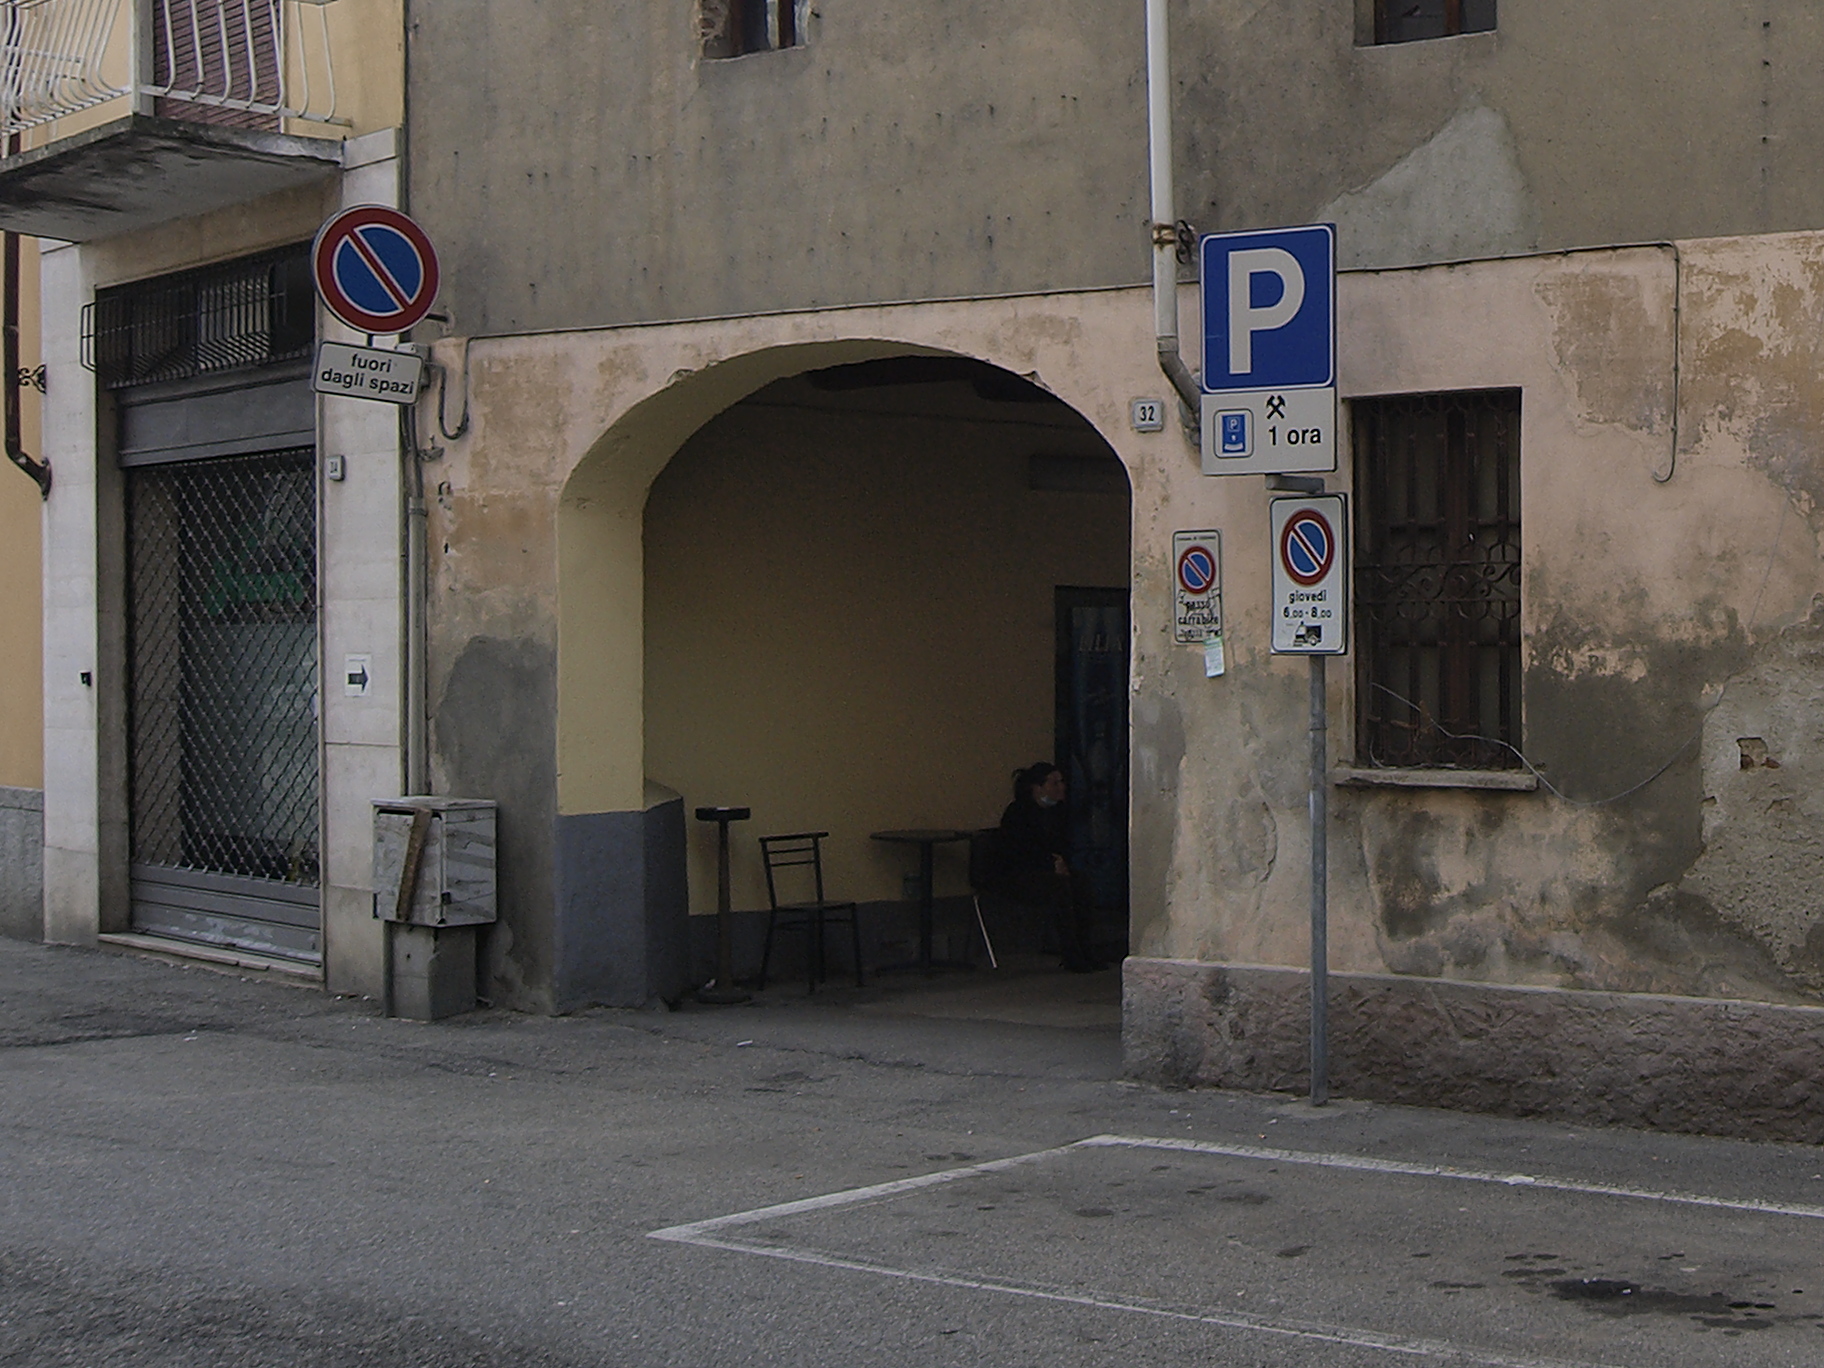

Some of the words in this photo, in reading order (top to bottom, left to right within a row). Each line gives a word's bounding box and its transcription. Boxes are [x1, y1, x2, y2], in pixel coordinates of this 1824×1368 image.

[1228, 247, 1306, 374] P
[351, 353, 393, 373] fuori
[321, 368, 365, 389] dagli
[369, 377, 414, 394] spazi
[1140, 405, 1155, 422] 32
[1268, 426, 1277, 446] 1
[1287, 427, 1321, 445] ora
